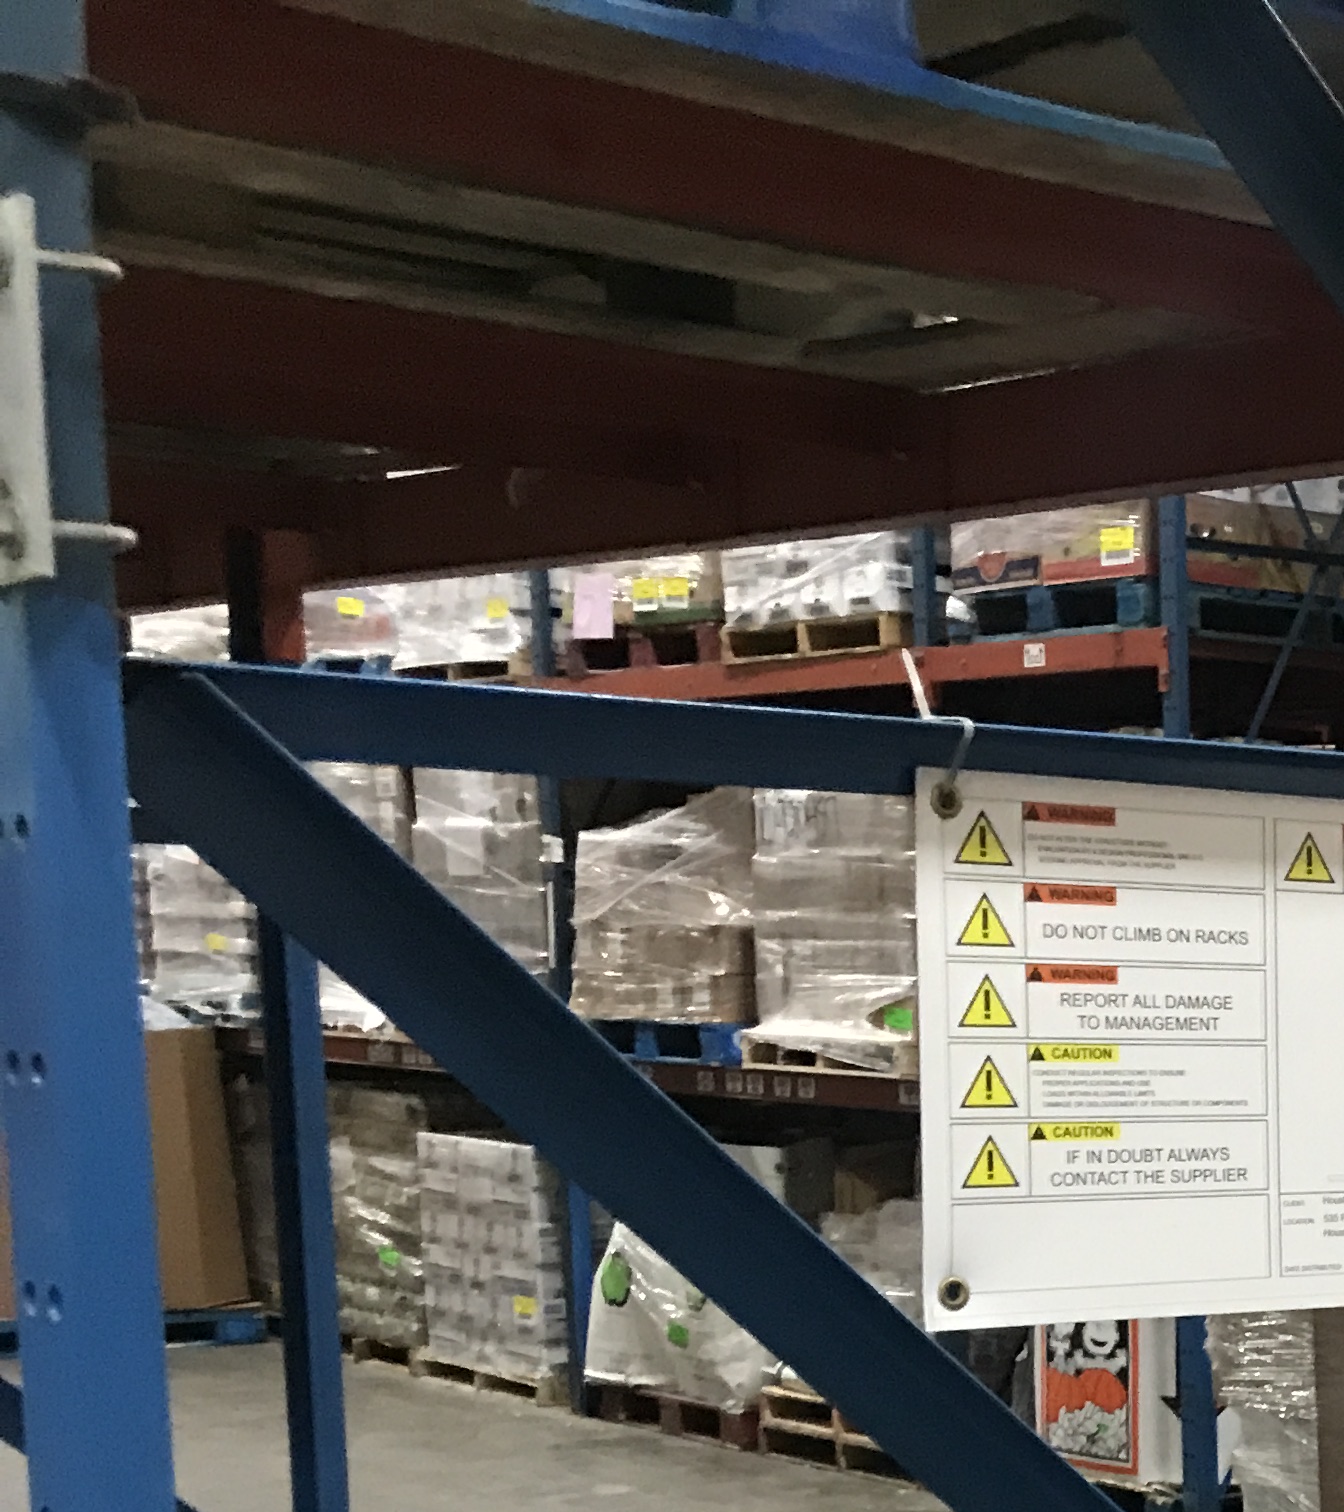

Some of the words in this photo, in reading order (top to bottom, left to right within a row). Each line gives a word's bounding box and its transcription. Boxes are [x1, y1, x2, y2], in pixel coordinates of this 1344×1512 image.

[1050, 885, 1115, 903] WARNING
[1042, 922, 1068, 940] DO
[1073, 924, 1107, 941] NOT
[1112, 925, 1162, 943] CLIMB
[1166, 928, 1190, 943] ON
[1195, 929, 1249, 945] RACKS
[1051, 968, 1116, 982] WARNING
[1059, 992, 1128, 1009] REPORT
[1132, 993, 1160, 1009] ALL
[1165, 994, 1233, 1011] DAMAGE
[1077, 1015, 1101, 1031] TO
[1104, 1015, 1220, 1032] MANAGEMENT
[1051, 1047, 1113, 1060] CAUTION
[1052, 1125, 1114, 1139] CAUTION
[1066, 1149, 1081, 1165] IF
[1086, 1149, 1102, 1164] IN
[1107, 1148, 1164, 1164] DOUBT
[1167, 1146, 1231, 1163] ALWAYS
[1050, 1170, 1129, 1187] CONTACT
[1134, 1169, 1166, 1185] THE
[1170, 1167, 1249, 1184] SUPPLIER
